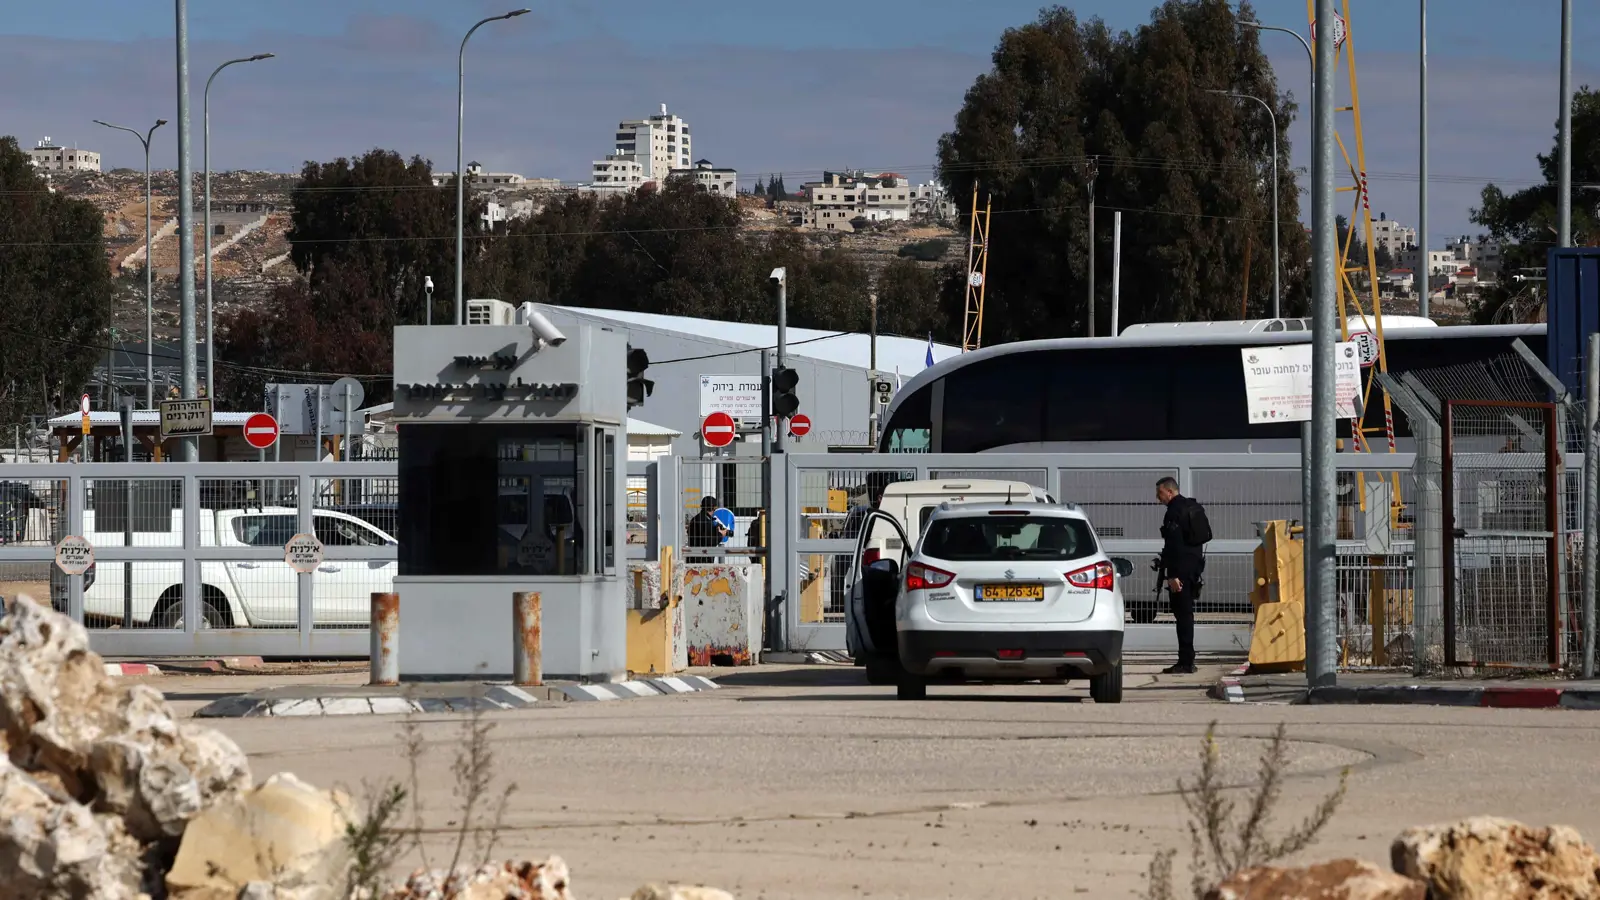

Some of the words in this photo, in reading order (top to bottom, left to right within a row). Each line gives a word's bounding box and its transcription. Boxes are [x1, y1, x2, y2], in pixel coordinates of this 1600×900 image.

[1251, 366, 1271, 376] עופר
[1274, 364, 1300, 375] למחנה
[1335, 361, 1354, 371] ברוכי
[712, 383, 734, 393] בידוק
[738, 383, 762, 391] עמדת
[168, 402, 202, 412] זהירות
[166, 411, 206, 421] דוקרנים
[60, 546, 90, 555] אילנית
[289, 545, 320, 553] אילנית
